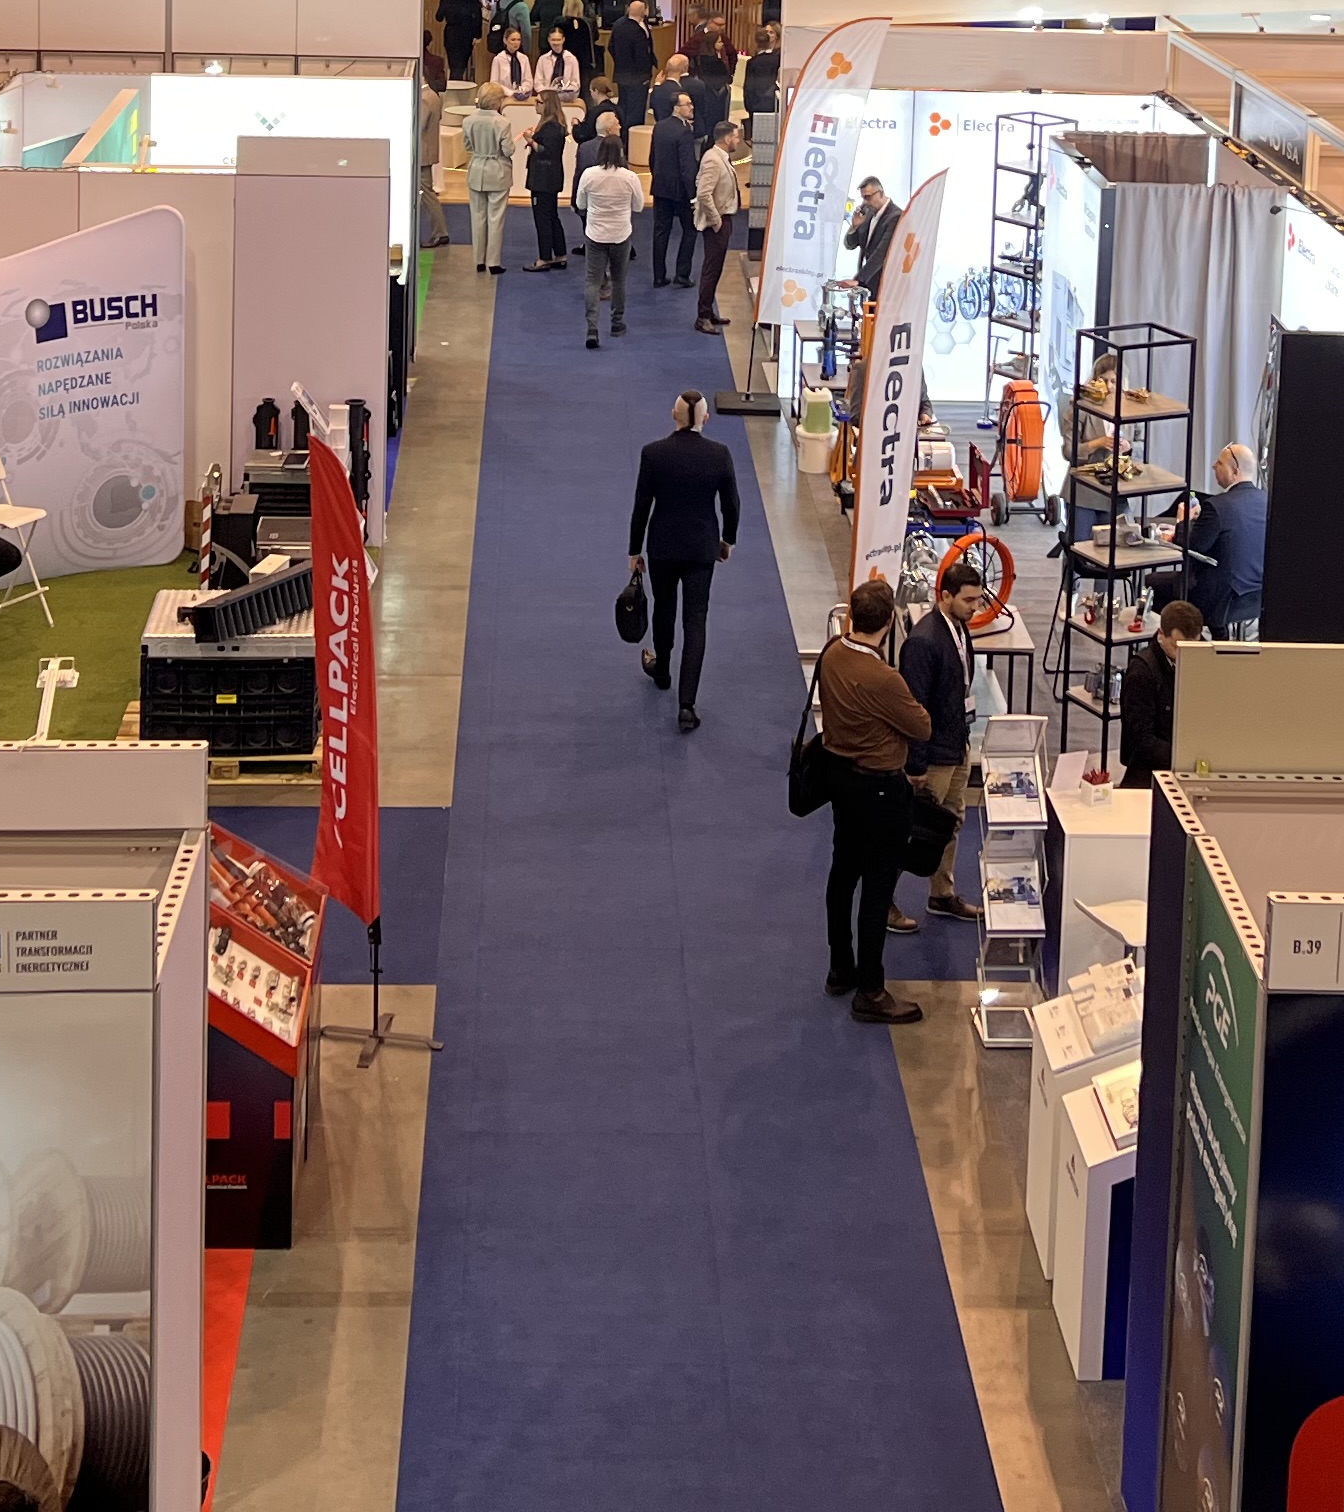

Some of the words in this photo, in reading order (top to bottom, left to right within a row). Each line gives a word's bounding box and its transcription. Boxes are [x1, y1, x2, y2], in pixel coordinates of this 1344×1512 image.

[793, 113, 840, 241] Electra
[72, 294, 157, 324] BUSCH
[125, 319, 158, 330] Polska
[37, 347, 123, 373] ROZWIĄZANIA
[38, 372, 112, 397] NAPĘDZANE
[39, 404, 65, 420] SIŁĄ
[69, 392, 139, 414] INNOWACJI
[879, 322, 912, 507] Electra
[328, 552, 350, 821] CELLPACK
[16, 930, 58, 941] PARTNER
[1293, 940, 1322, 955] B.39
